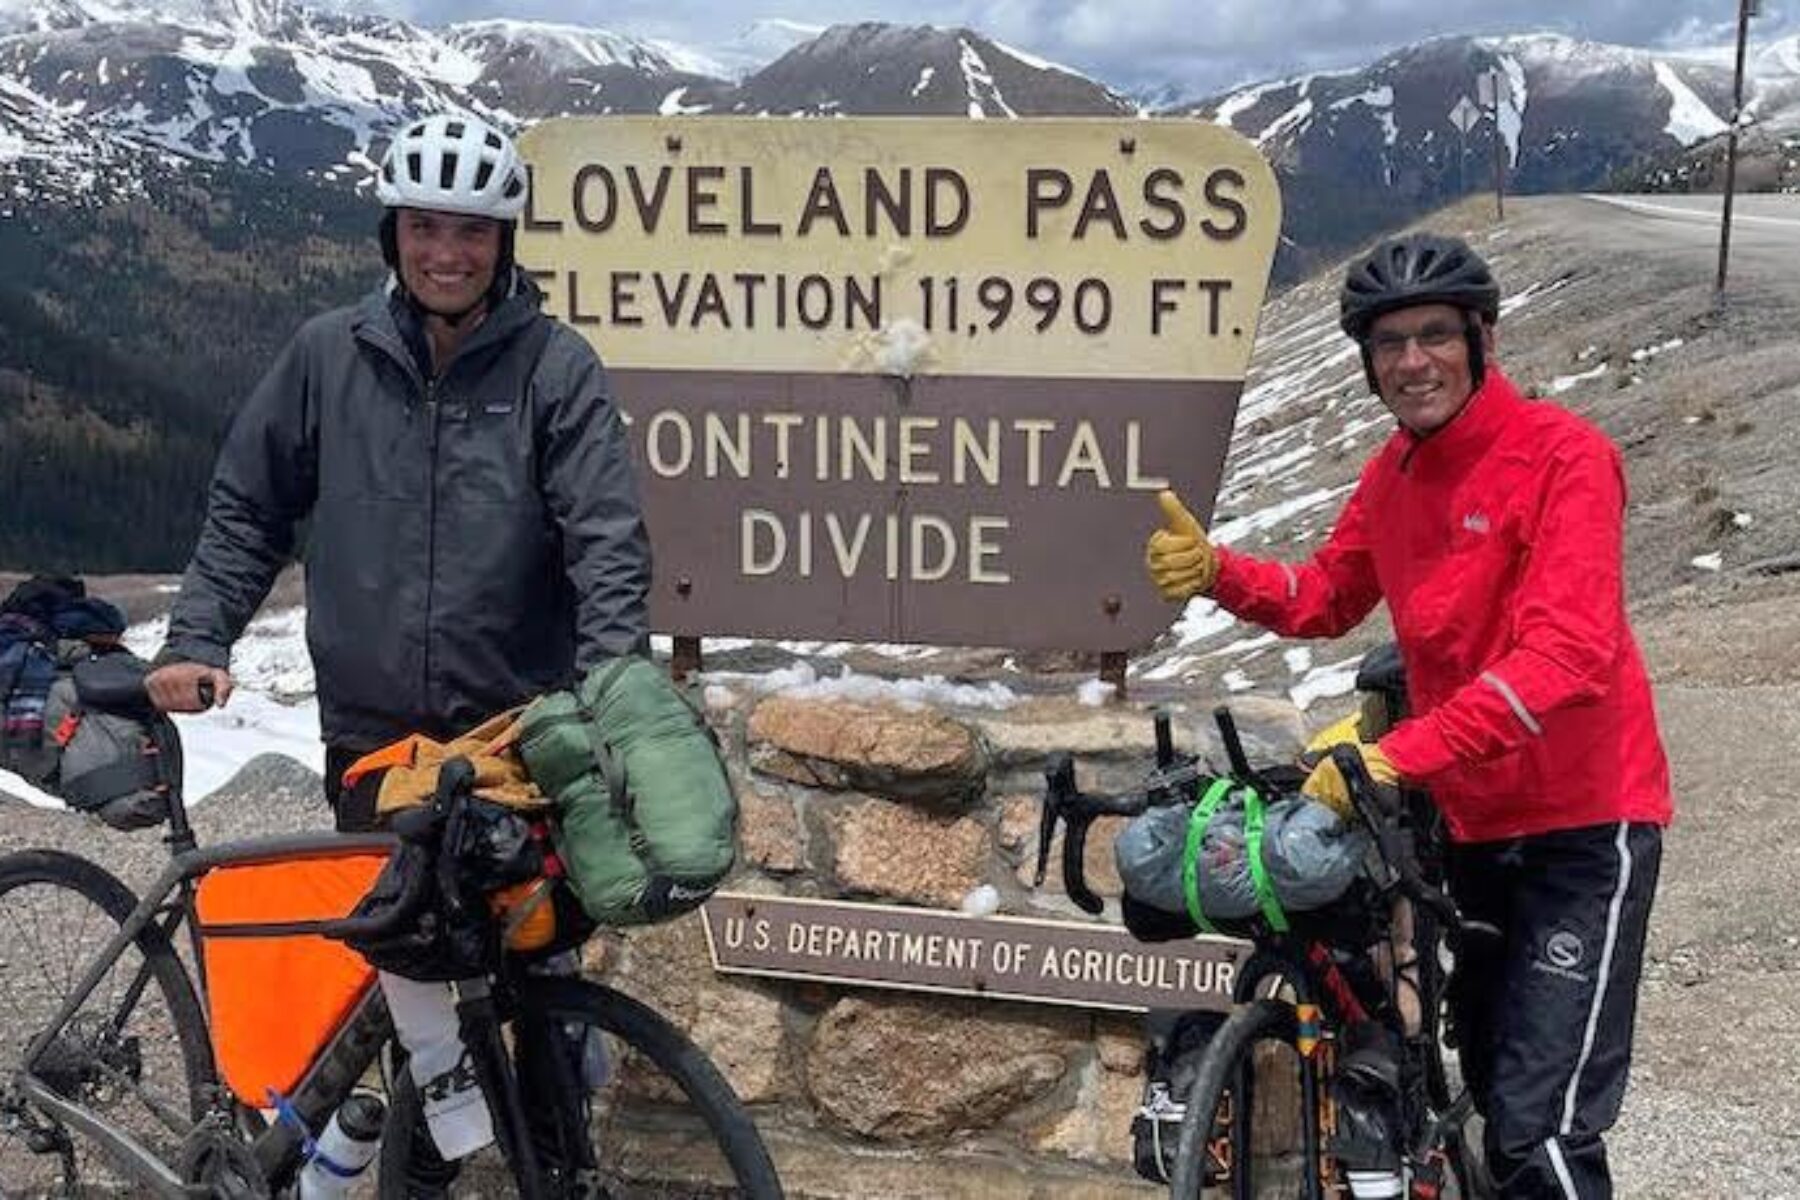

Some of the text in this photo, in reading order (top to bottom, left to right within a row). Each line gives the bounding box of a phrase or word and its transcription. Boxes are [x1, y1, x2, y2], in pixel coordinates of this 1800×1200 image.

[524, 164, 1248, 240] LOVELAND PASS
[919, 277, 1112, 336] 11,990
[1151, 280, 1242, 336] FT.
[619, 410, 1169, 490] ONTINENTAL
[741, 510, 1010, 583] DIVIDE
[725, 919, 1234, 995] U.S. DEPARTMENT OF AGRICULTUR
